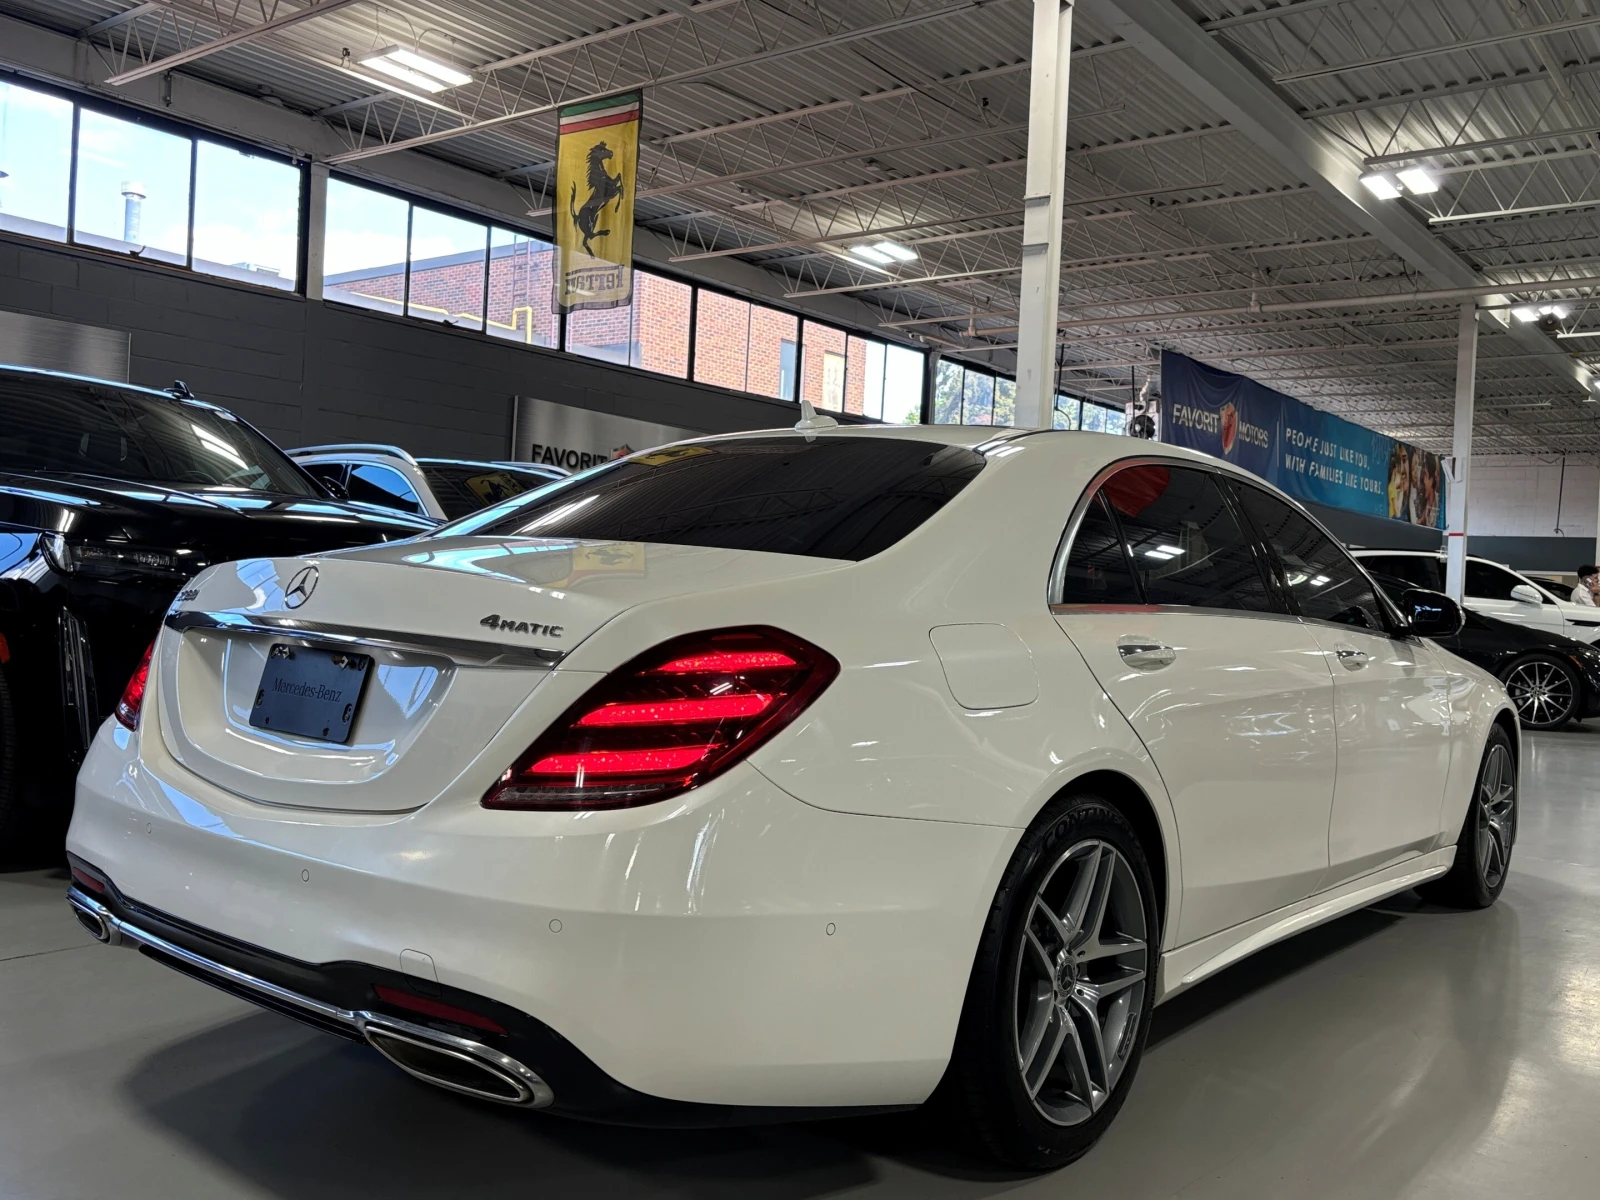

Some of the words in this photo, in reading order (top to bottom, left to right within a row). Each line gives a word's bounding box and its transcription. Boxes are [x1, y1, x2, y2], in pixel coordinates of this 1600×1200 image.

[1172, 403, 1219, 434] FAVORIT
[1239, 421, 1268, 448] MOTORS
[532, 444, 608, 470] FAVORIT
[1320, 440, 1337, 459] JUST
[1340, 446, 1353, 464] LIKE
[1285, 453, 1306, 474] WITH
[1309, 461, 1343, 484] FAMILIES
[1345, 472, 1357, 489] LIKE
[1360, 476, 1384, 495] YOURS.
[480, 614, 564, 638] 4MATIC
[271, 677, 343, 703] Mercedes-Benz
